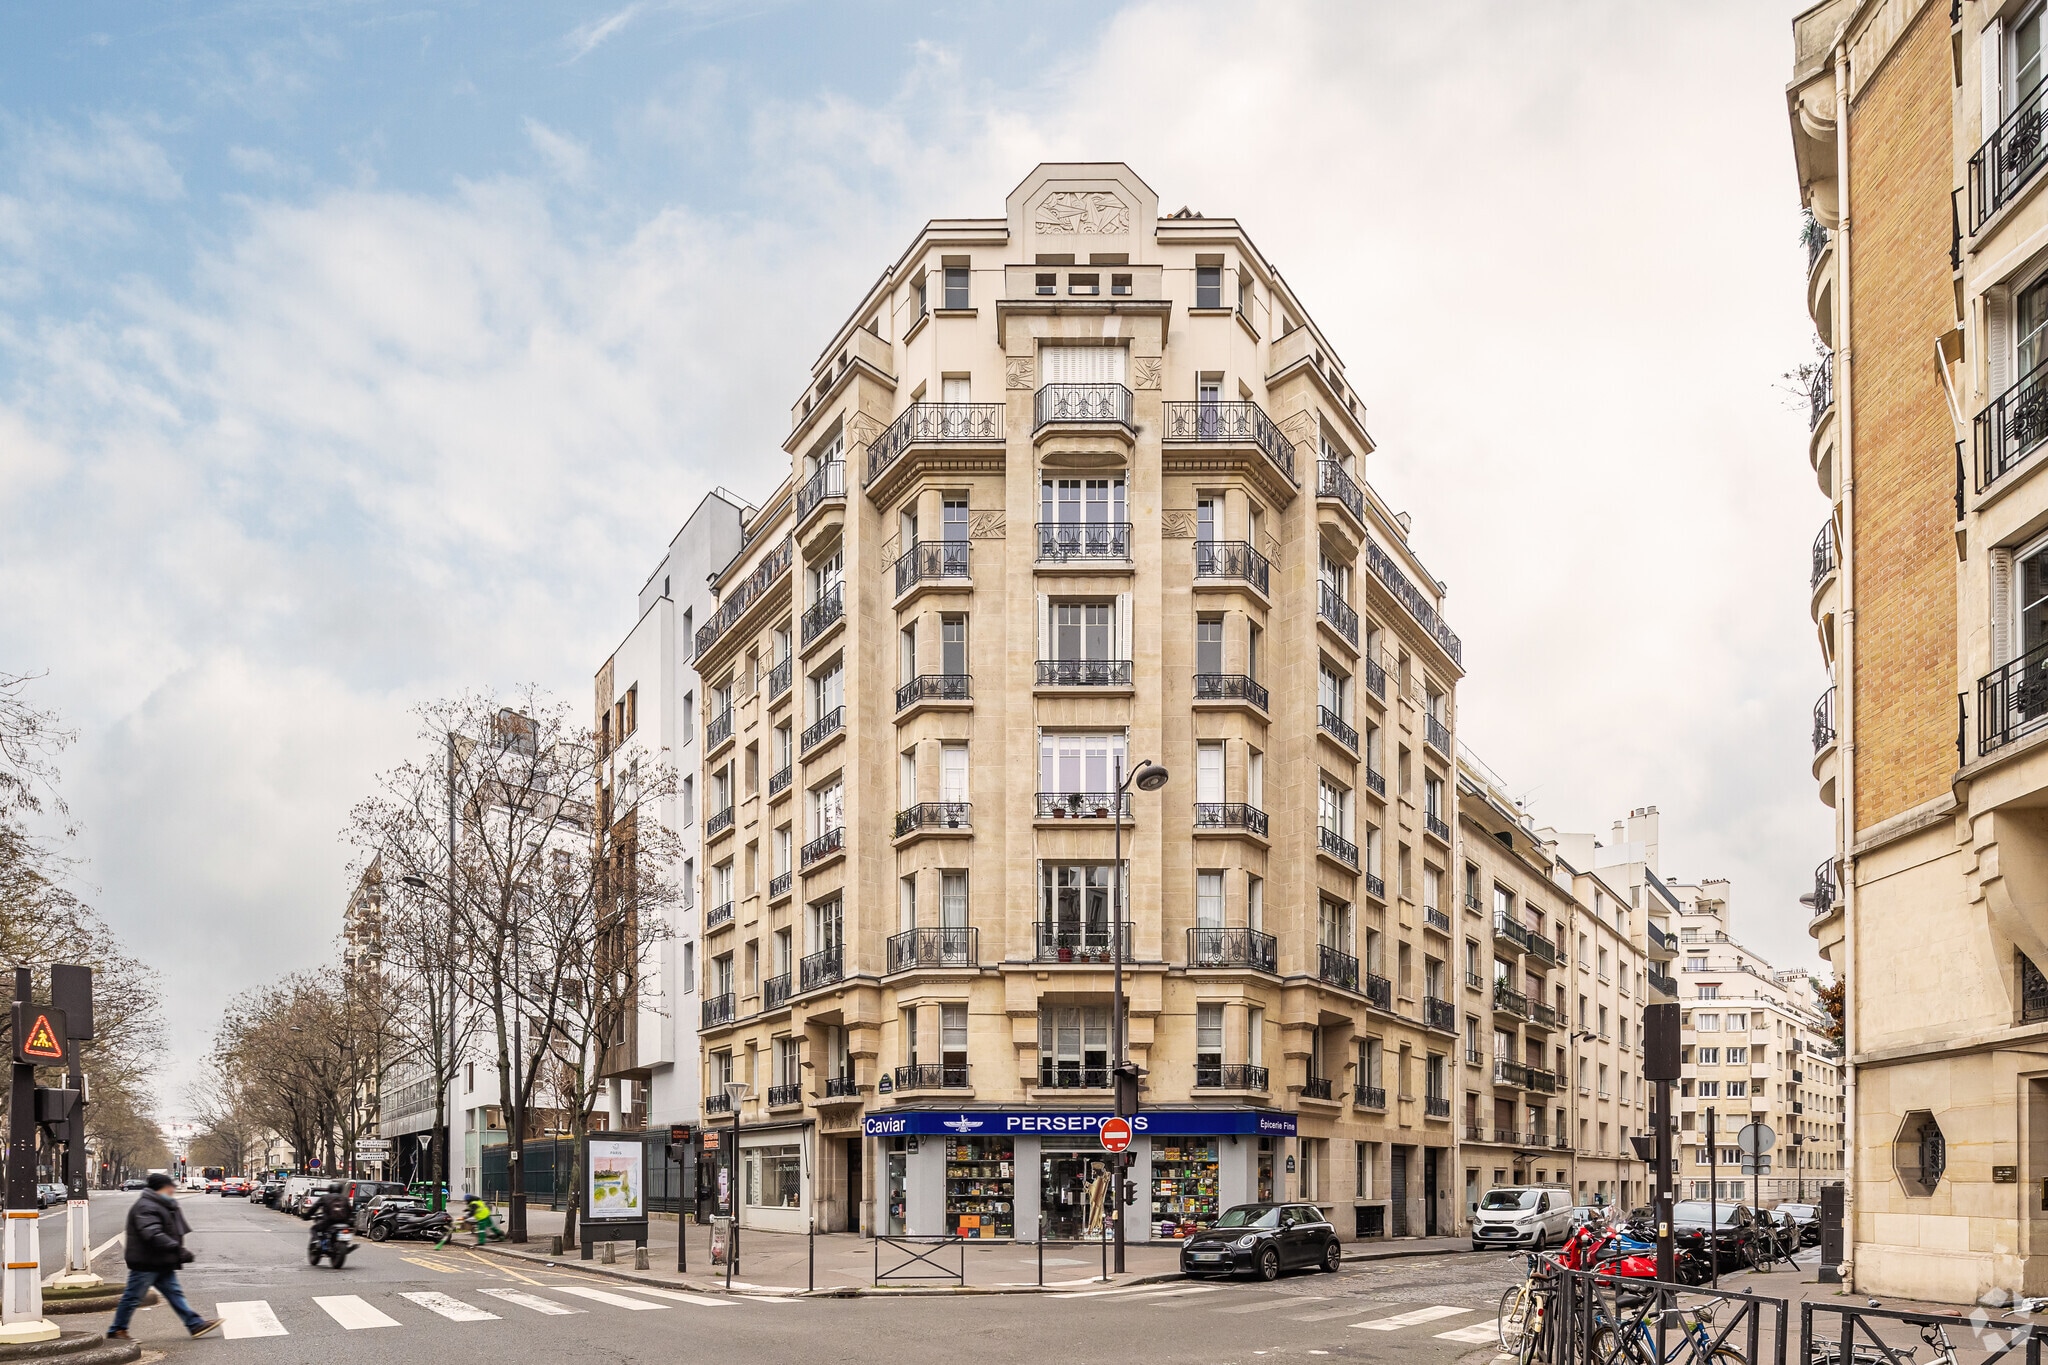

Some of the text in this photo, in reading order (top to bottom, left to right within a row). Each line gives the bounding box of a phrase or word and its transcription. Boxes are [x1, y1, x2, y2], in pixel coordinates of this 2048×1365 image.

[866, 1117, 906, 1134] Caviar
[1007, 1117, 1148, 1131] PERSEPOIS
[1260, 1117, 1295, 1131] Épicerie Fine
